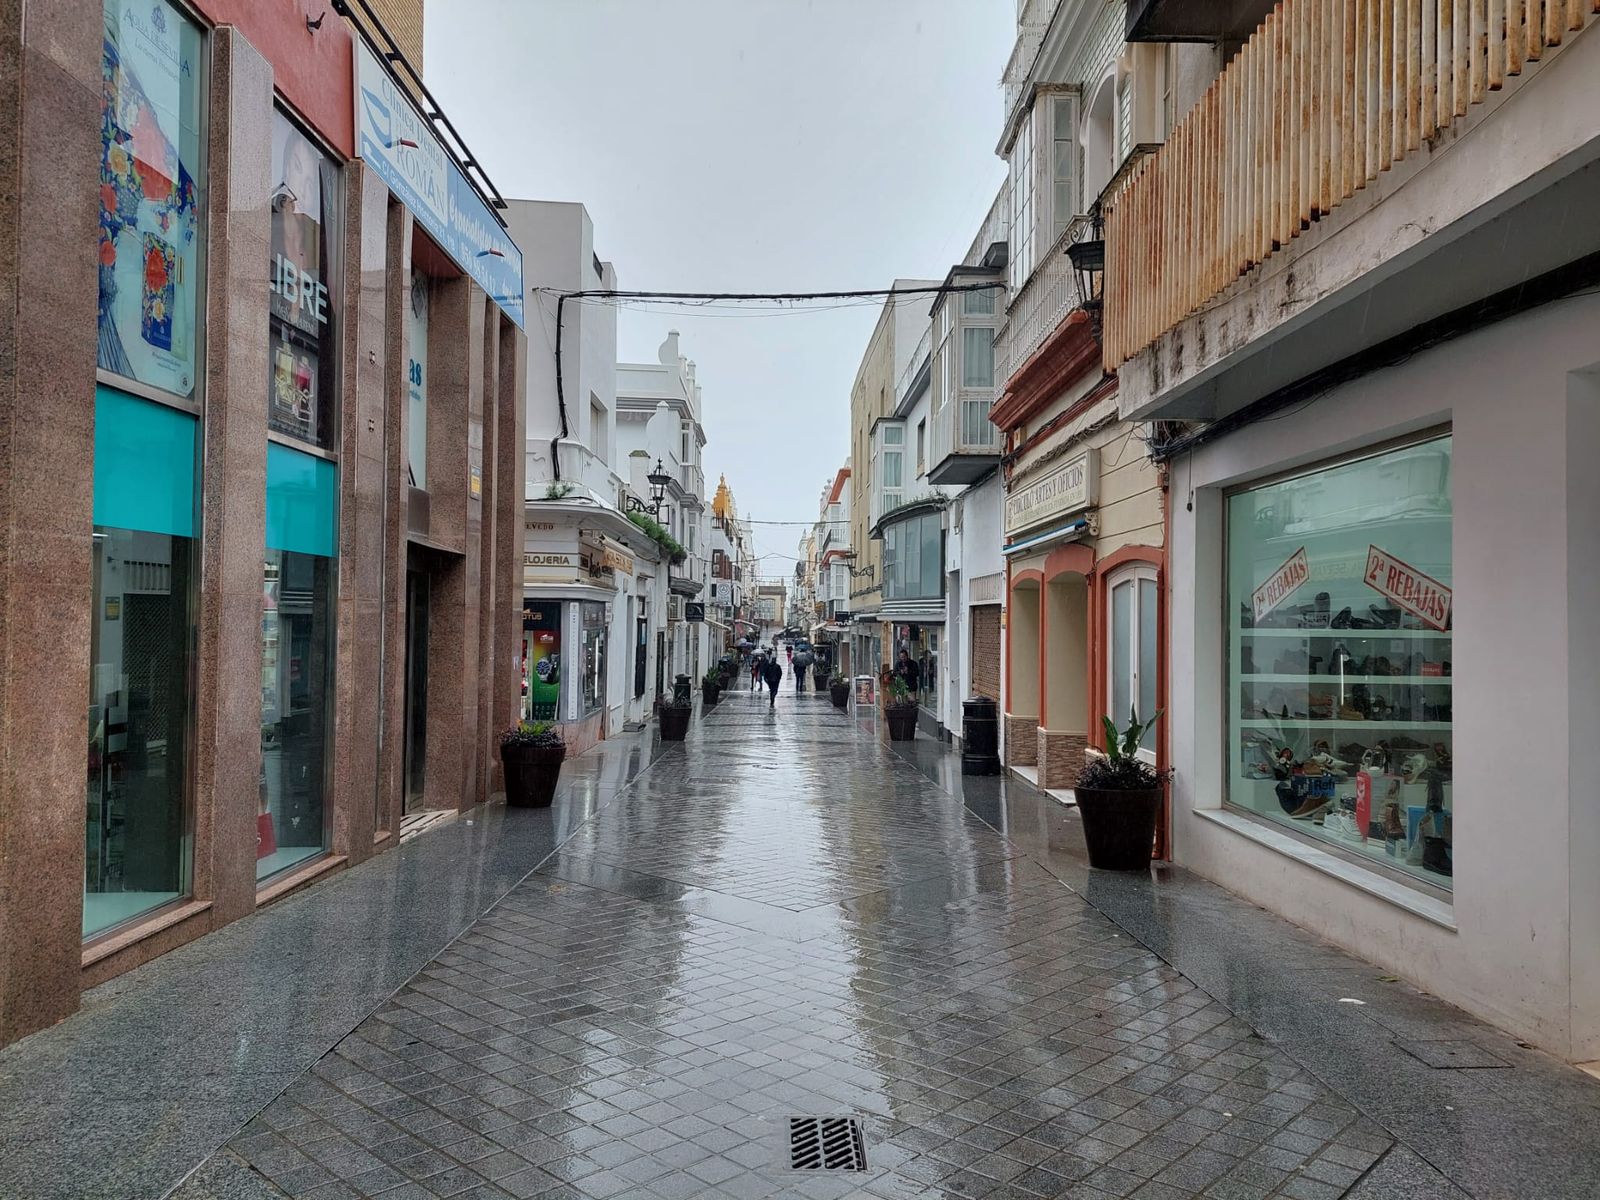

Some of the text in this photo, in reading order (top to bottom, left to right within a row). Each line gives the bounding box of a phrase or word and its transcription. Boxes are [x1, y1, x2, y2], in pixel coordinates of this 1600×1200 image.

[416, 122, 444, 171] Dental
[396, 144, 448, 219] ROMÁN
[1266, 556, 1307, 607] REBAJAS
[1386, 564, 1446, 621] REBAJAS
